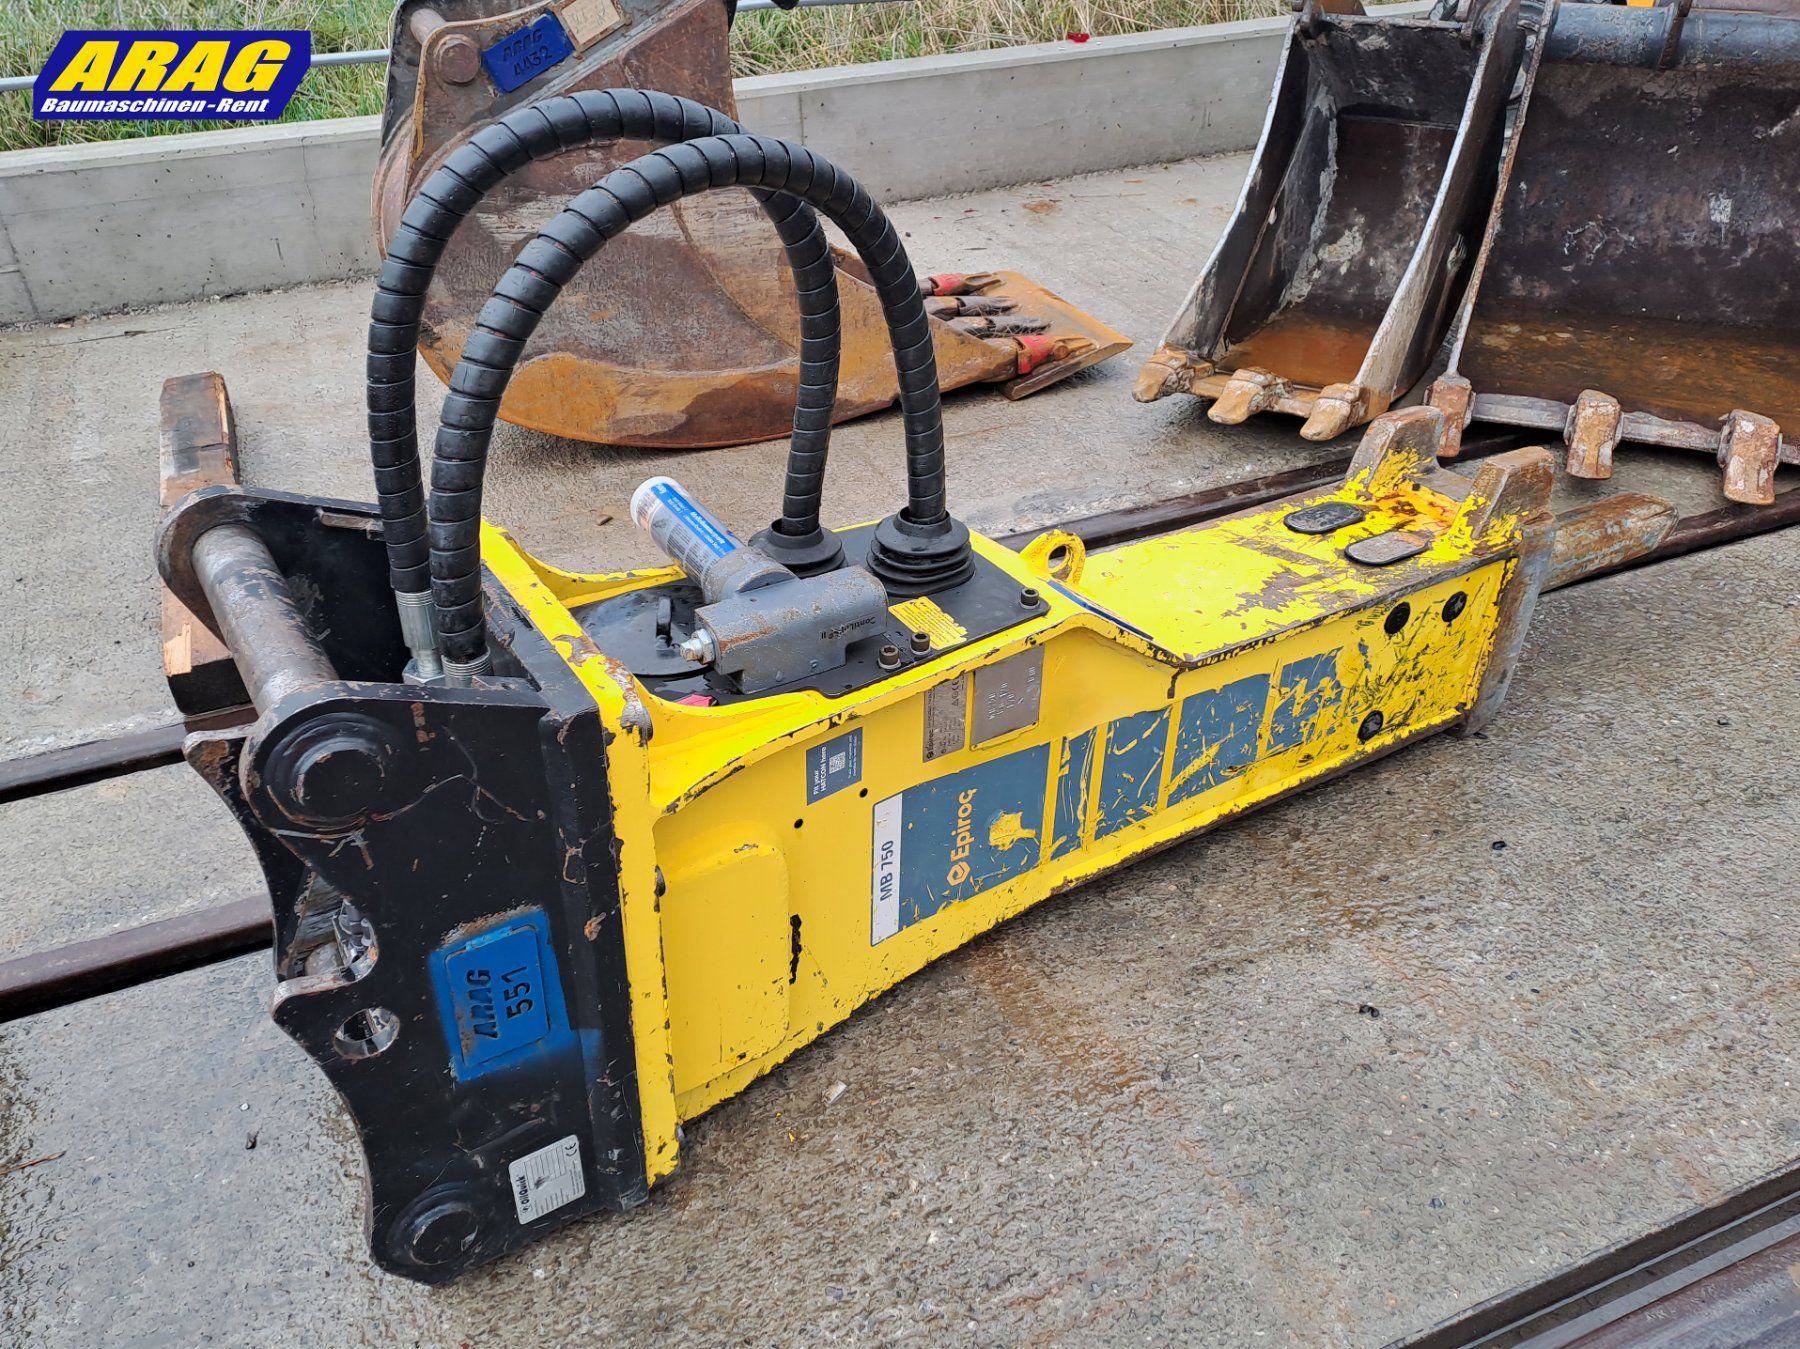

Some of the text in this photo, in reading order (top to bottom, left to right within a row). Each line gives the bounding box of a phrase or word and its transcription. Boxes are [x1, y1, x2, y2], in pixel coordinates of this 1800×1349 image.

[503, 28, 543, 61] ARAG
[951, 788, 977, 862] Epiroc
[880, 840, 894, 901] MB 750
[466, 970, 498, 1038] ARAG
[501, 966, 534, 1019] 551
[516, 1175, 530, 1205] OilQuick
